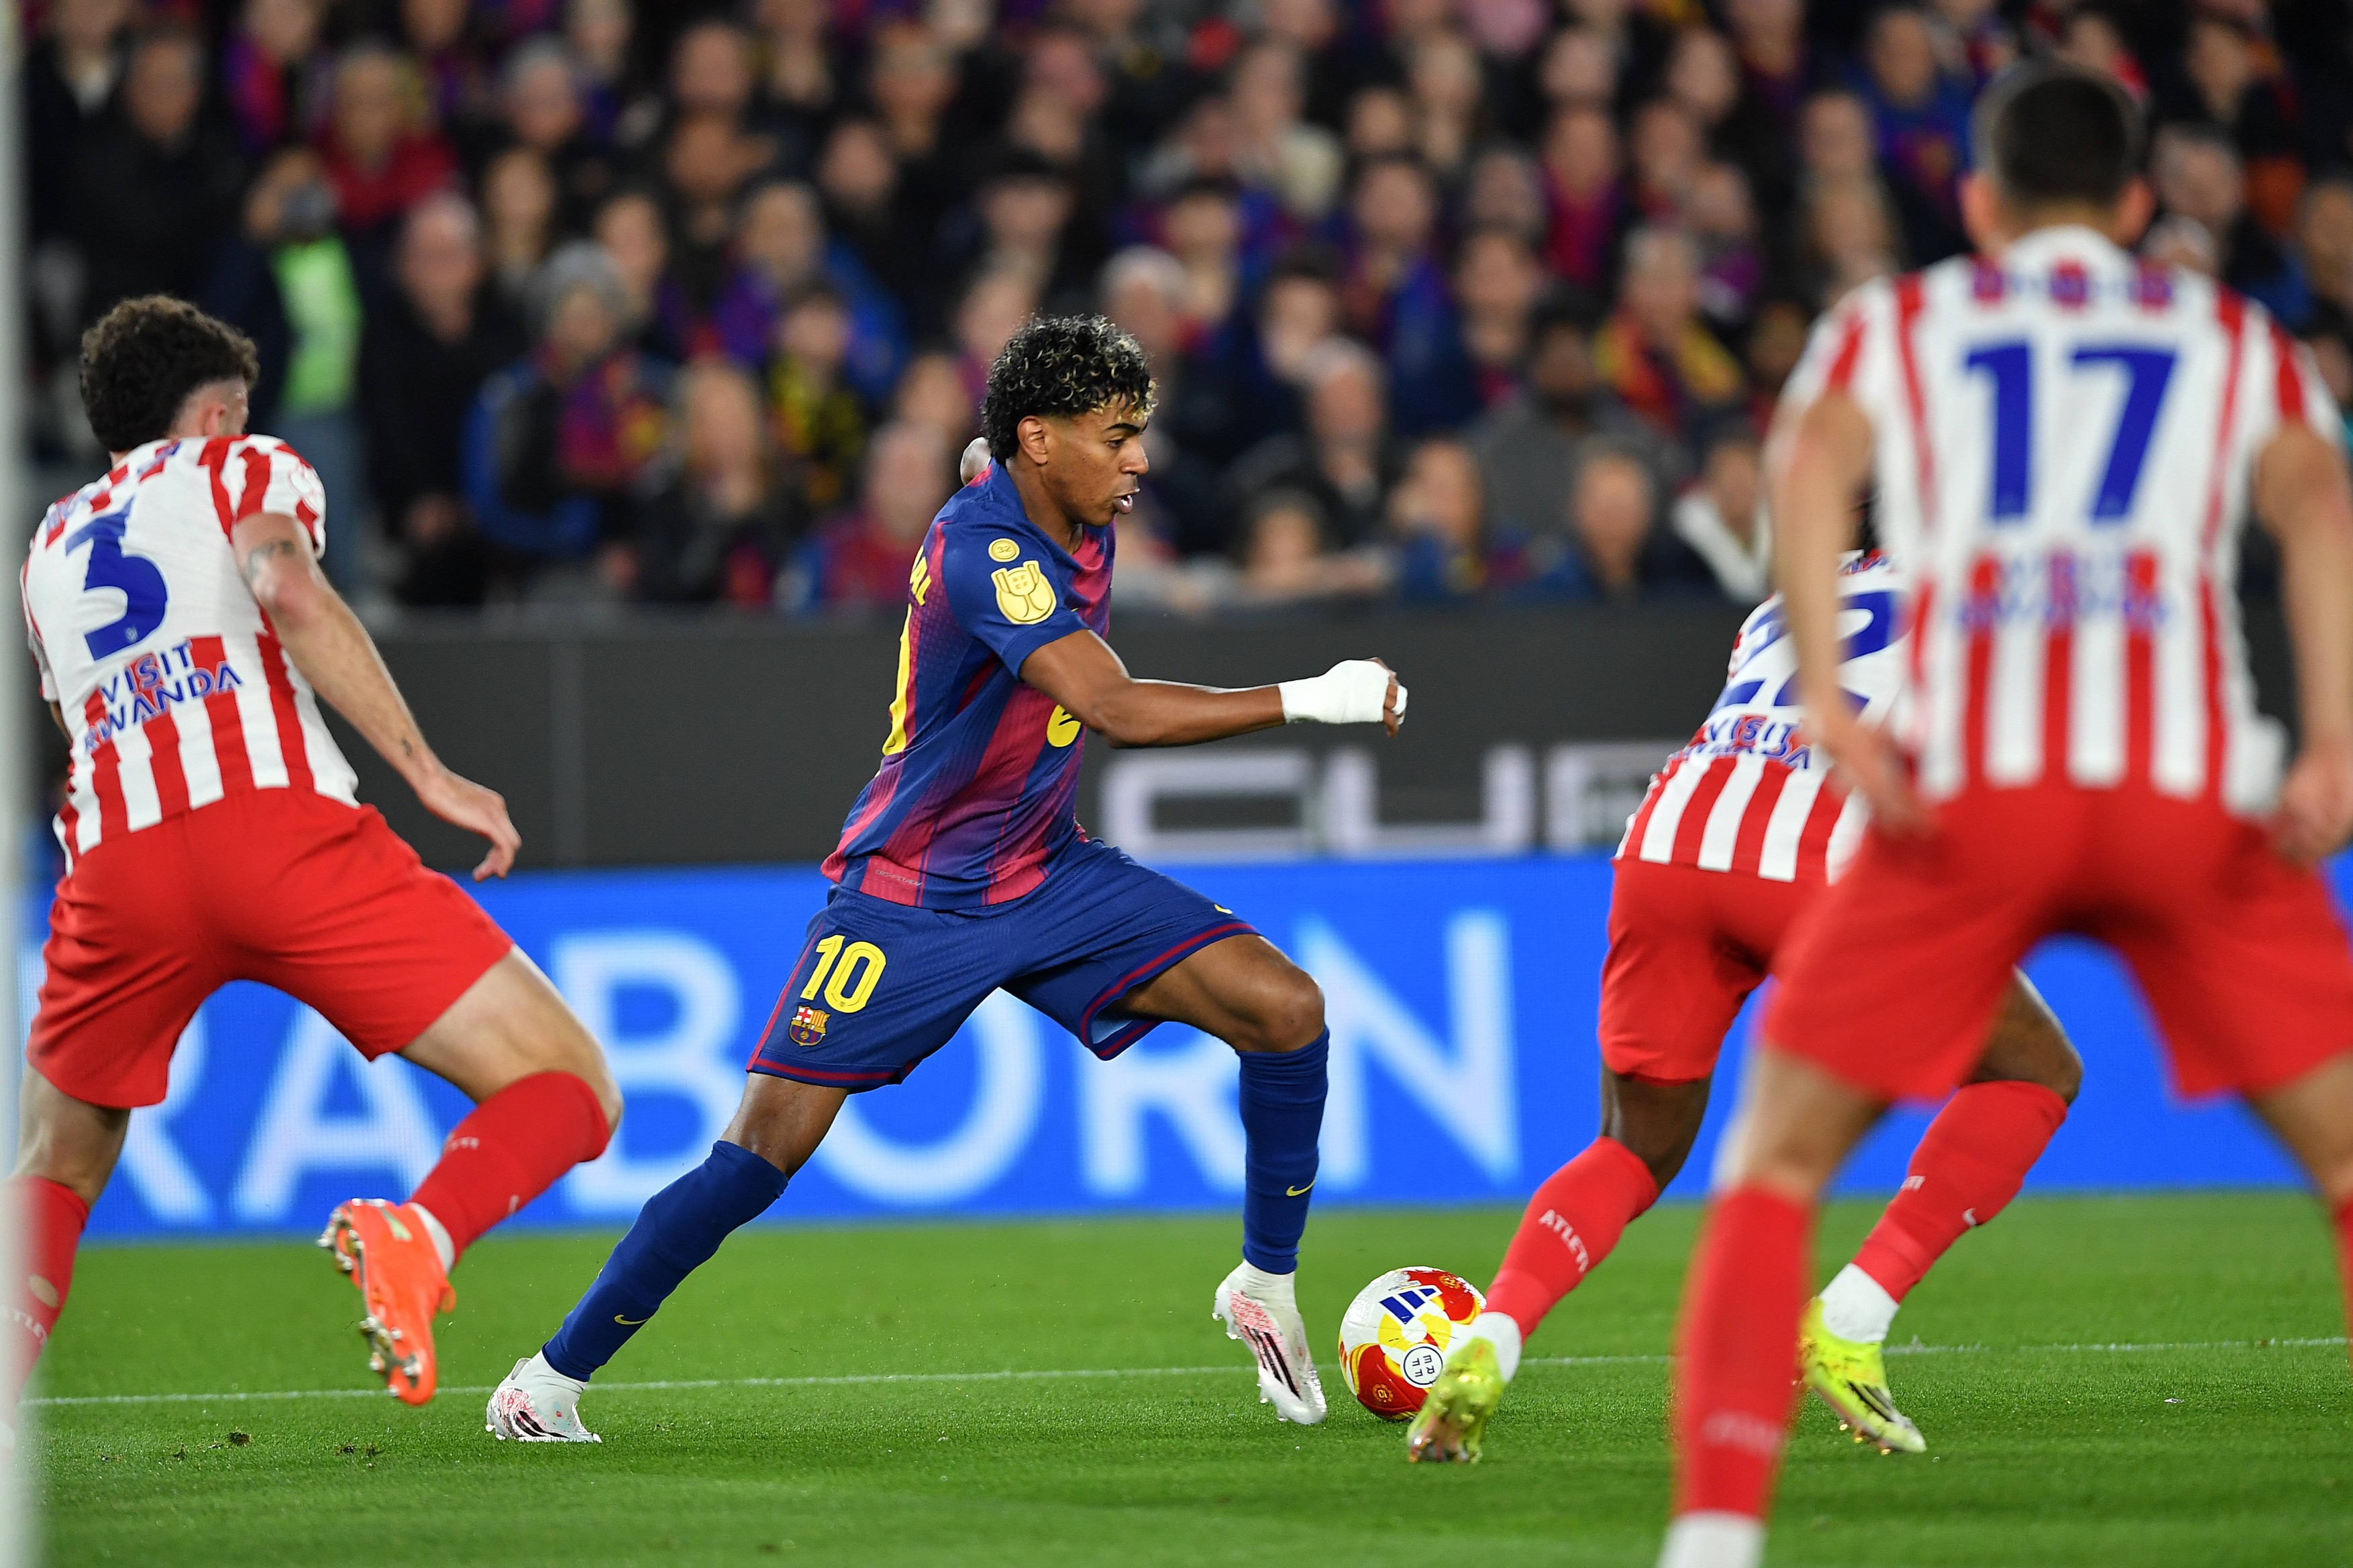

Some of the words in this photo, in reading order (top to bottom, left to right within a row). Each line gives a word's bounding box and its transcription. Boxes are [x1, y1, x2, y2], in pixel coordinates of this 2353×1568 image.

[1963, 339, 2179, 525] 17
[65, 493, 168, 661] 3
[909, 545, 931, 606] AL
[101, 639, 192, 704] VISIT
[1710, 717, 1803, 744] VISIT
[800, 934, 886, 1013] 10
